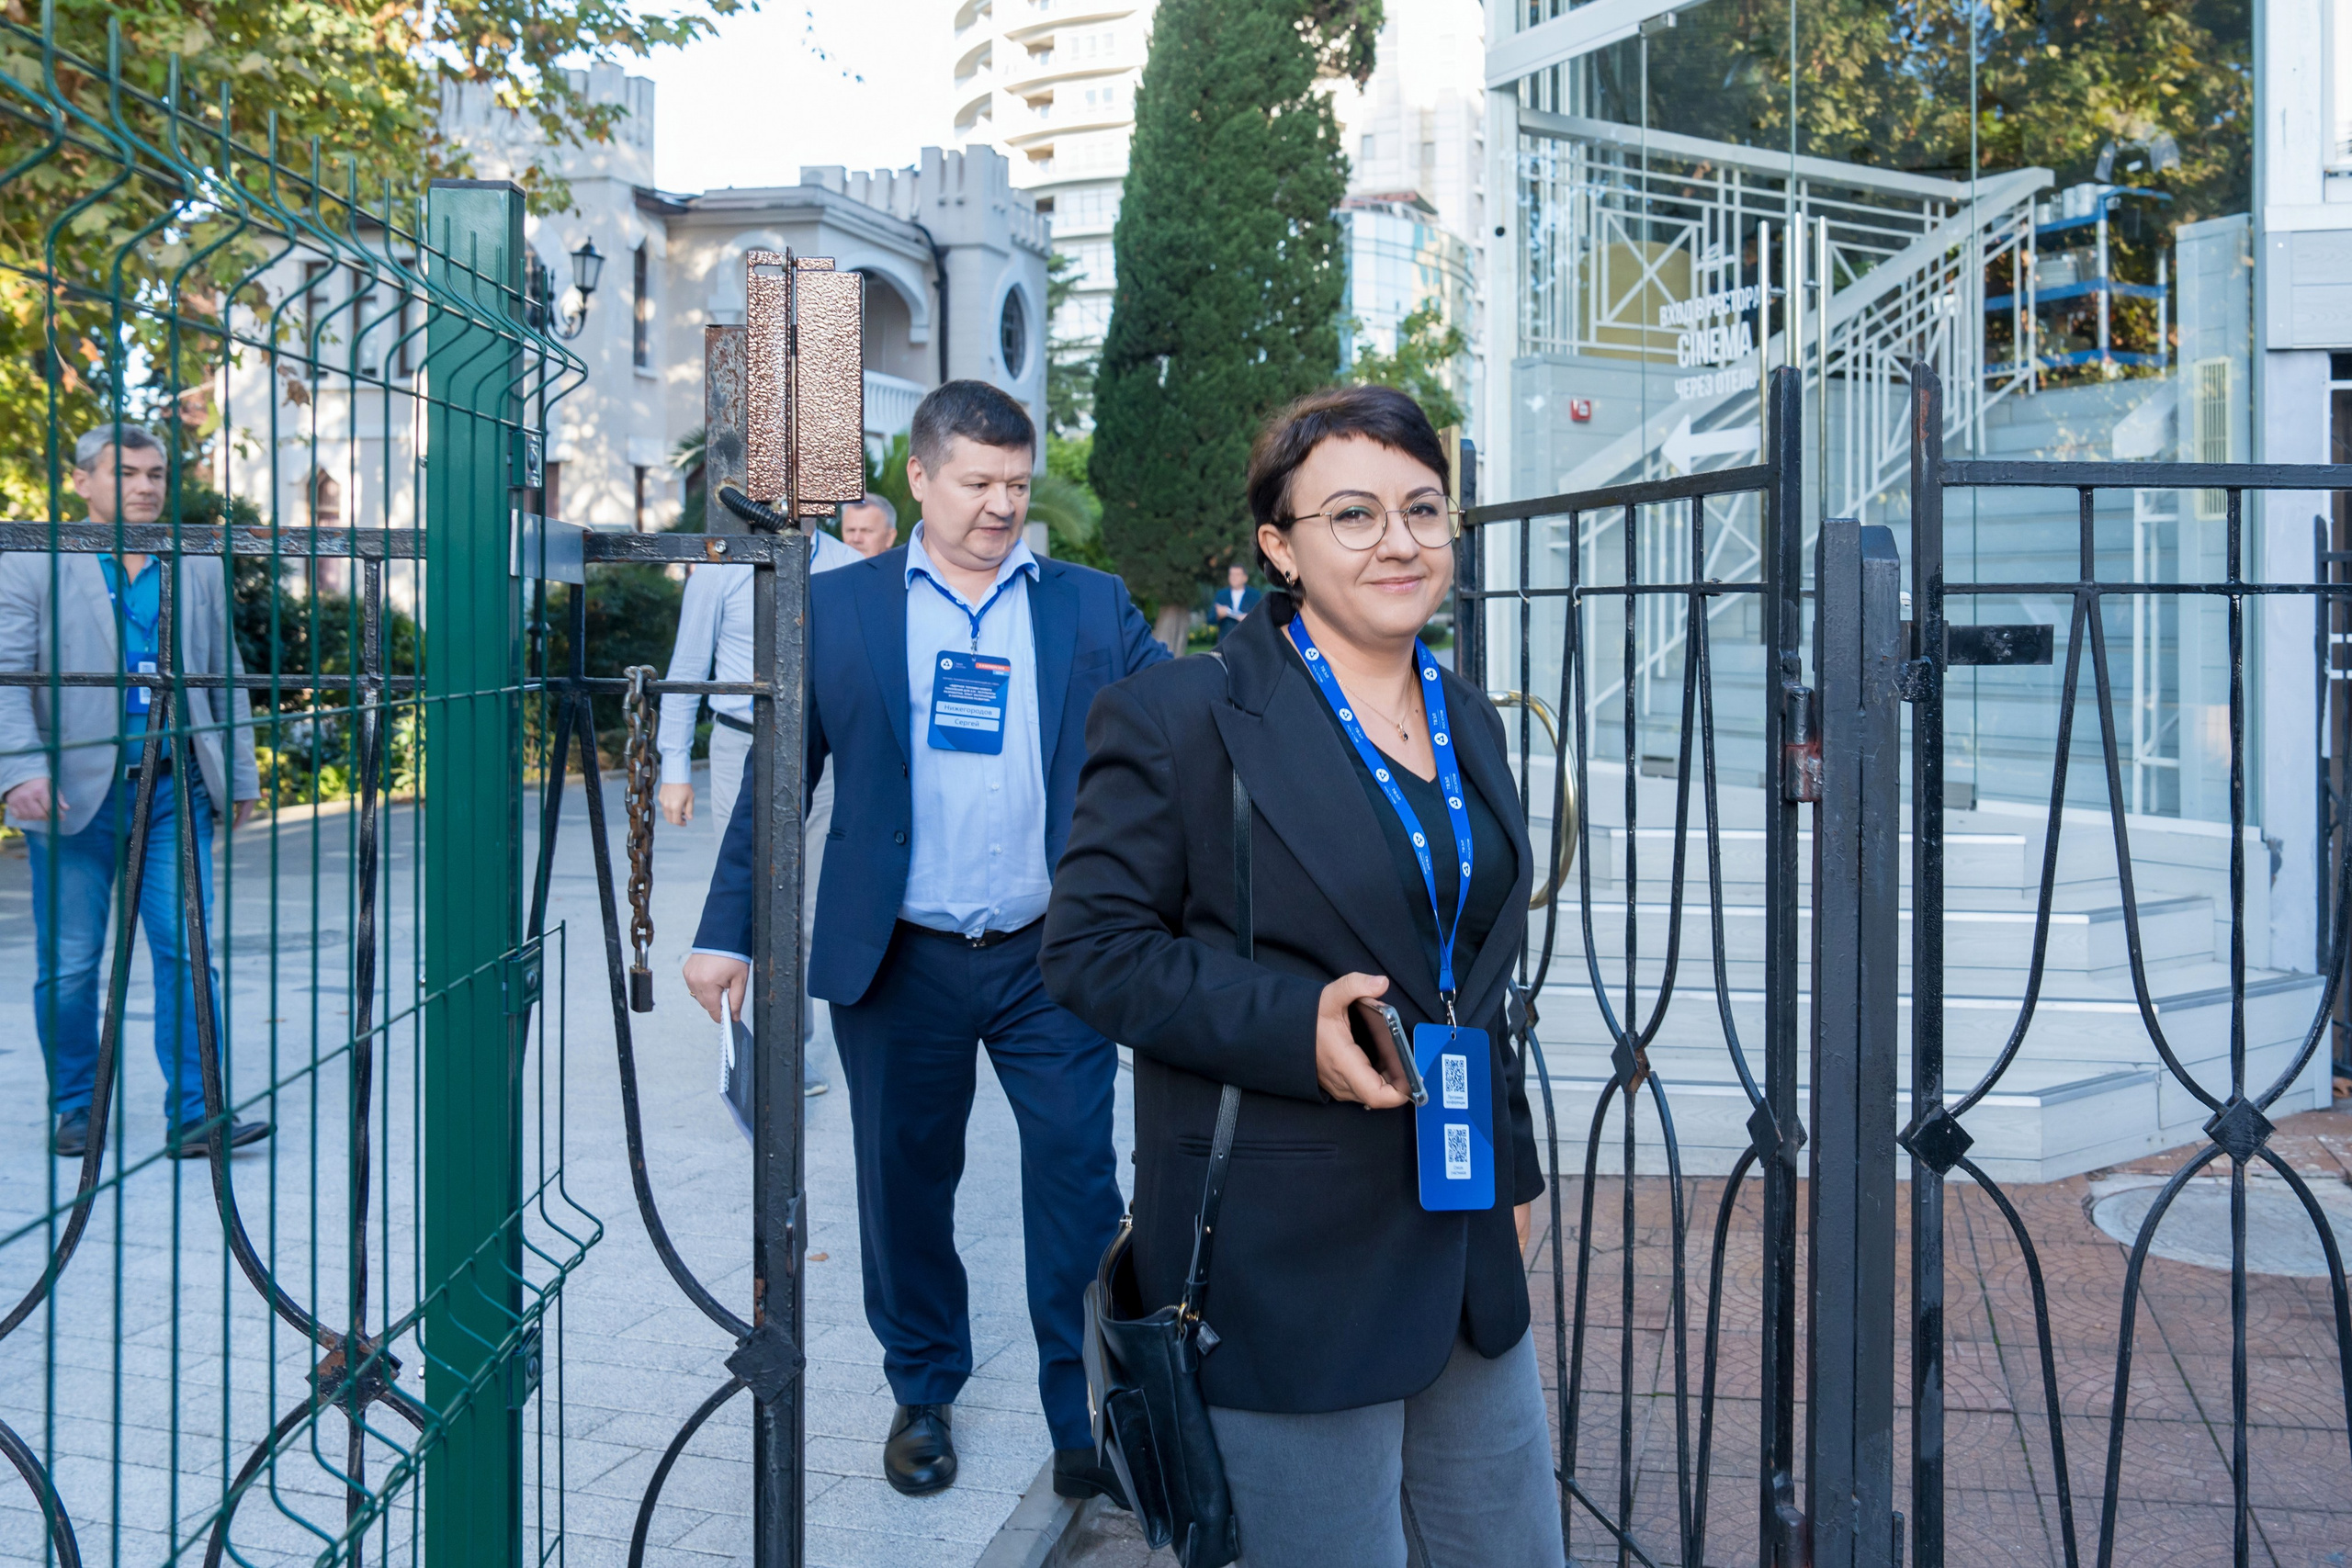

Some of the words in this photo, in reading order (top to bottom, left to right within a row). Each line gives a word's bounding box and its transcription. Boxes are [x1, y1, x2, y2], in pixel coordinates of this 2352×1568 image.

[1659, 299, 1692, 328] ВХОД
[1695, 297, 1705, 321] В
[1706, 282, 1772, 319] РЕСТОРА
[1678, 321, 1754, 368] CINEMA
[1675, 373, 1713, 400] ЧЕРЕЗ
[1714, 367, 1759, 395] ОТЕЛЬ
[944, 704, 993, 716] Нижегородов
[954, 718, 980, 728] Сергей
